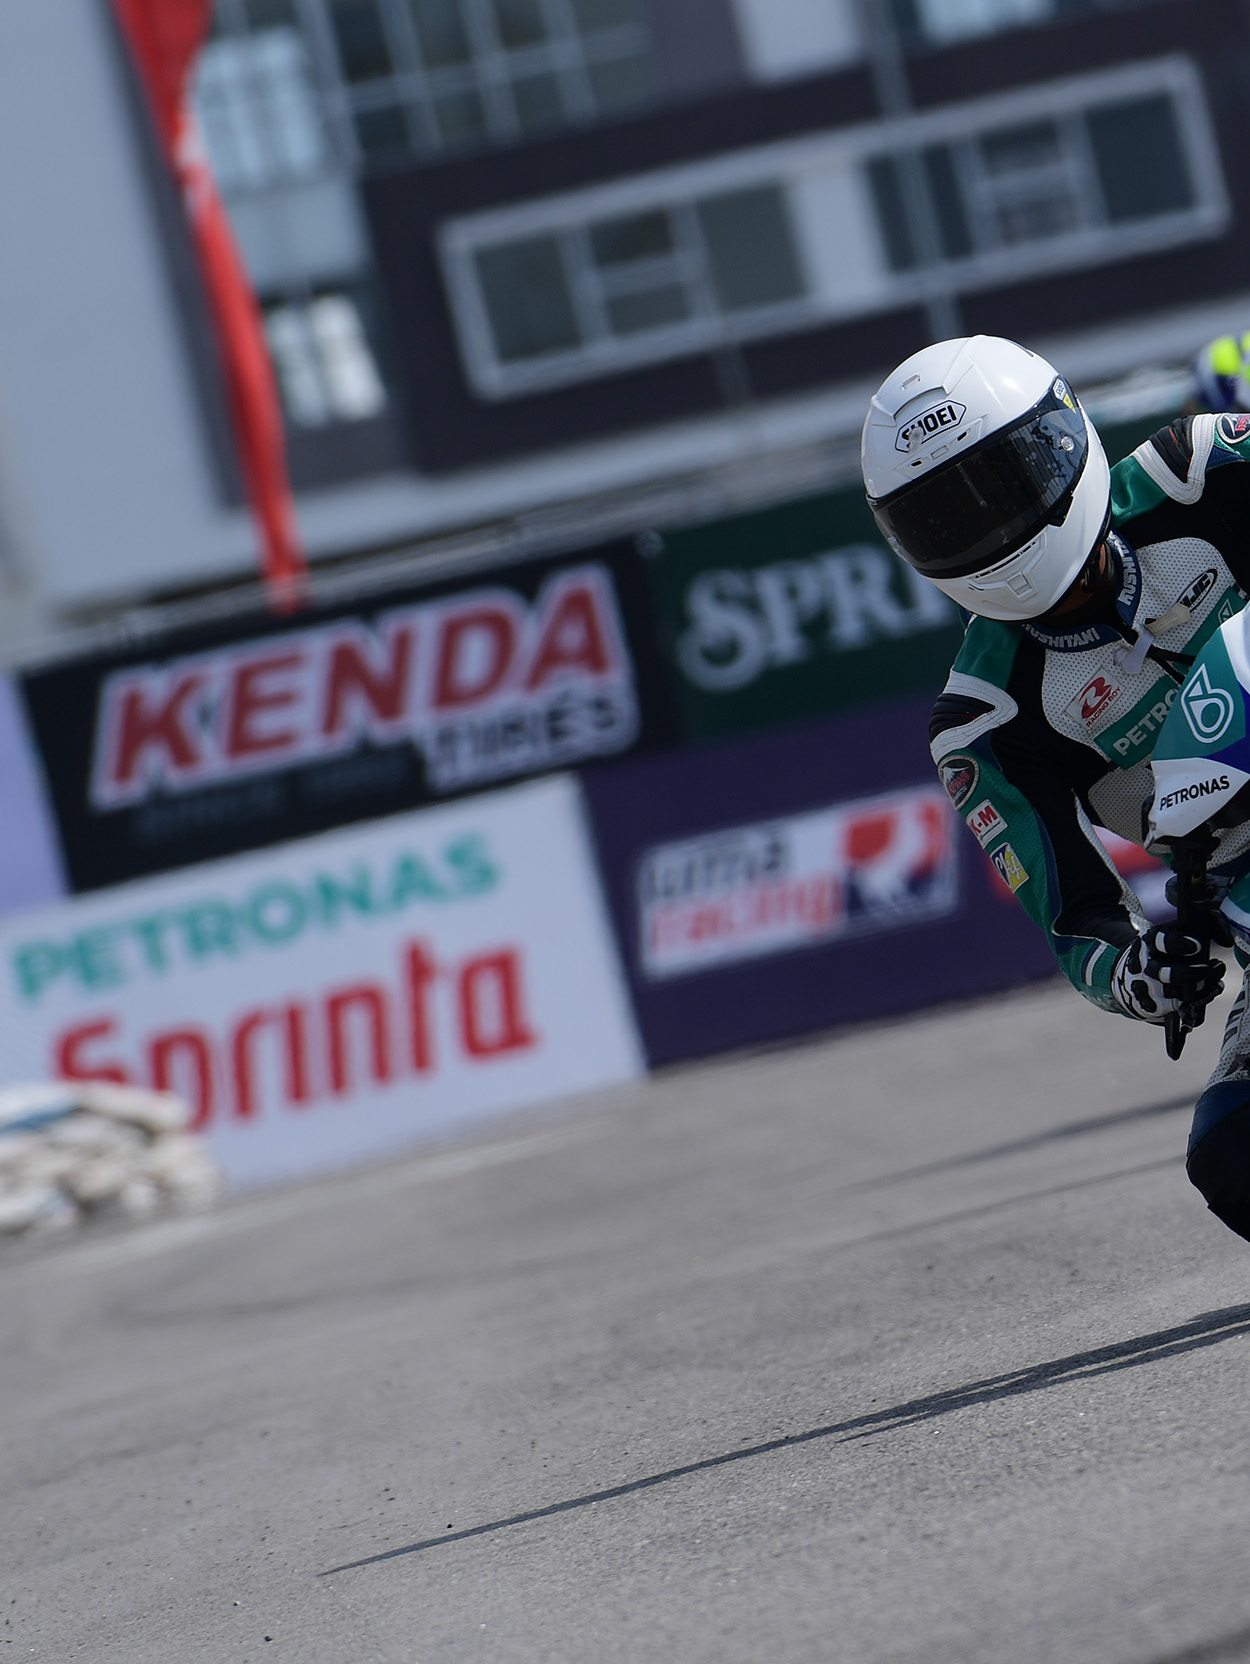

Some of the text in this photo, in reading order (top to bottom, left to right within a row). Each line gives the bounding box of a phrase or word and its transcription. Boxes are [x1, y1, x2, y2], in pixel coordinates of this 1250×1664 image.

[98, 566, 622, 798] KENDA
[1086, 701, 1109, 728] RACING
[1159, 774, 1230, 811] PETRONAS
[10, 832, 502, 1000] PETRONAS
